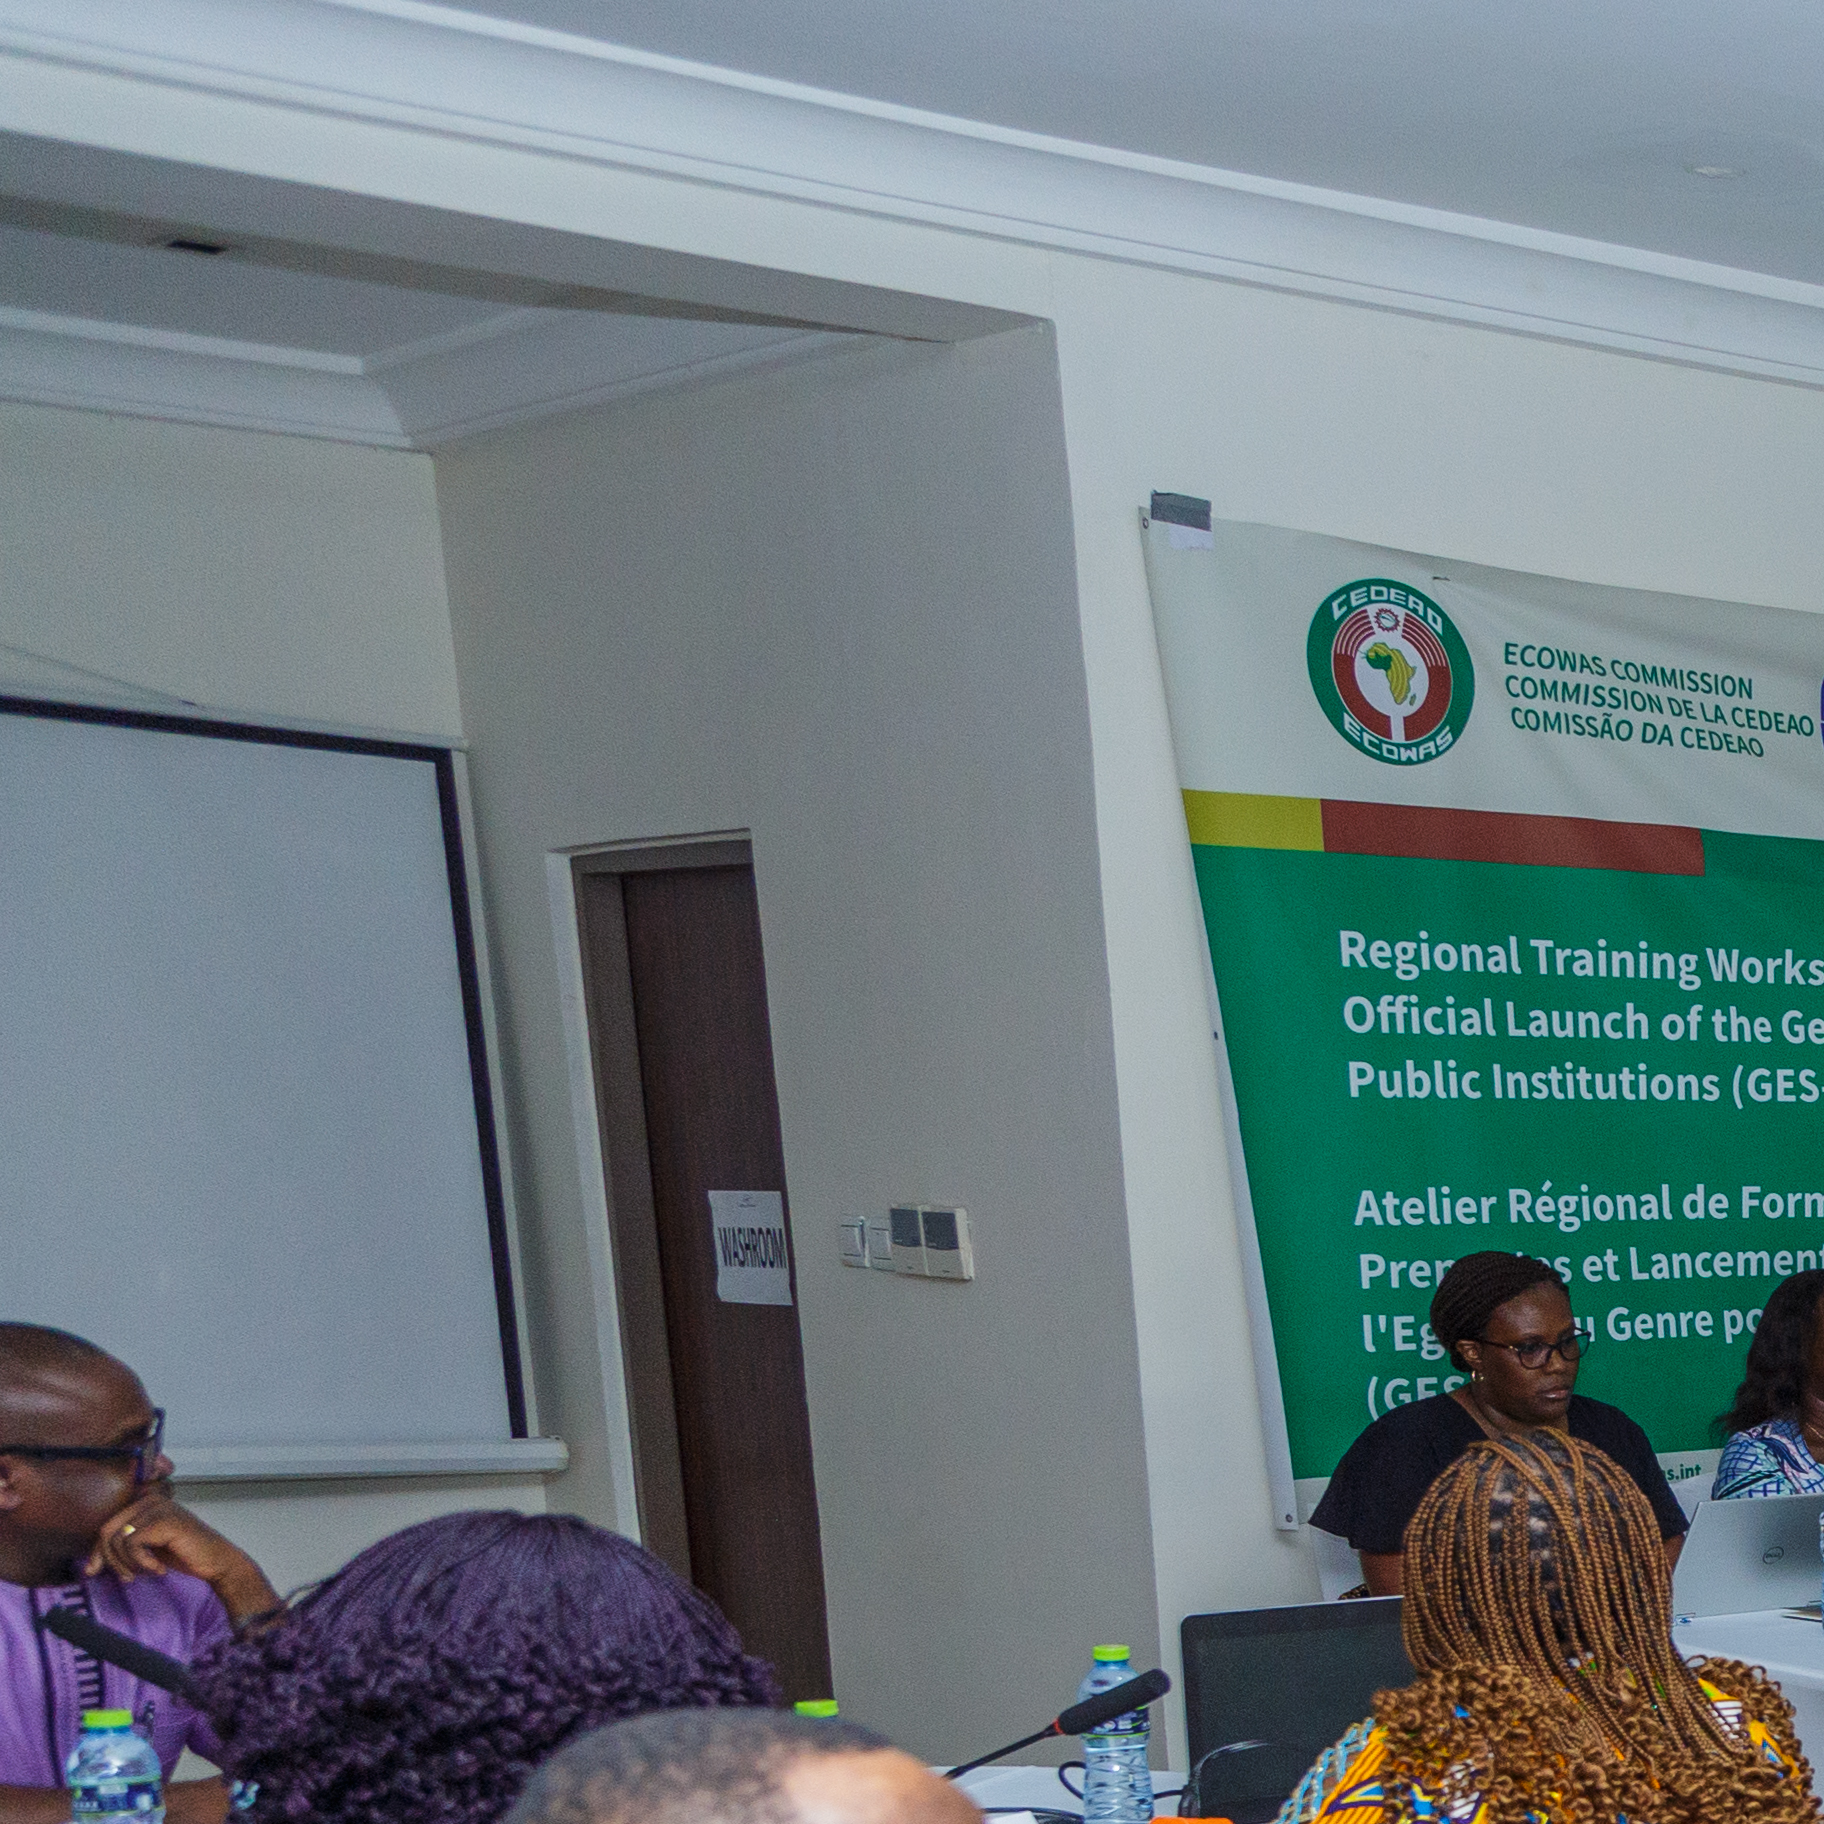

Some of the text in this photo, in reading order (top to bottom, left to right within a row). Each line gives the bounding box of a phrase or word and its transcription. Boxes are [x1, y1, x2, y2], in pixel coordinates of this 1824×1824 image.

[1332, 586, 1443, 636] CEDEAO
[1504, 642, 1753, 700] ECOWAS COMMISSION
[1505, 675, 1815, 737] COMMISSION DE LA CEDEAO
[1344, 712, 1453, 761] ECOWAS
[1511, 706, 1764, 757] COMISSÃO DA CEDEAO
[1340, 929, 1522, 981] Regional
[1530, 938, 1700, 990] Training
[1343, 994, 1498, 1039] Official
[1506, 999, 1651, 1042] Launch
[1660, 1003, 1703, 1043] of
[1710, 1005, 1774, 1046] the
[1348, 1059, 1481, 1102] Public
[1491, 1061, 1721, 1105] Institutions
[1355, 1184, 1497, 1227] Atelier
[1508, 1180, 1673, 1234] Régional
[1681, 1182, 1729, 1221] de
[718, 1227, 787, 1270] WASHROOM
[1582, 1248, 1620, 1282] et
[1607, 1306, 1714, 1341] Genre
